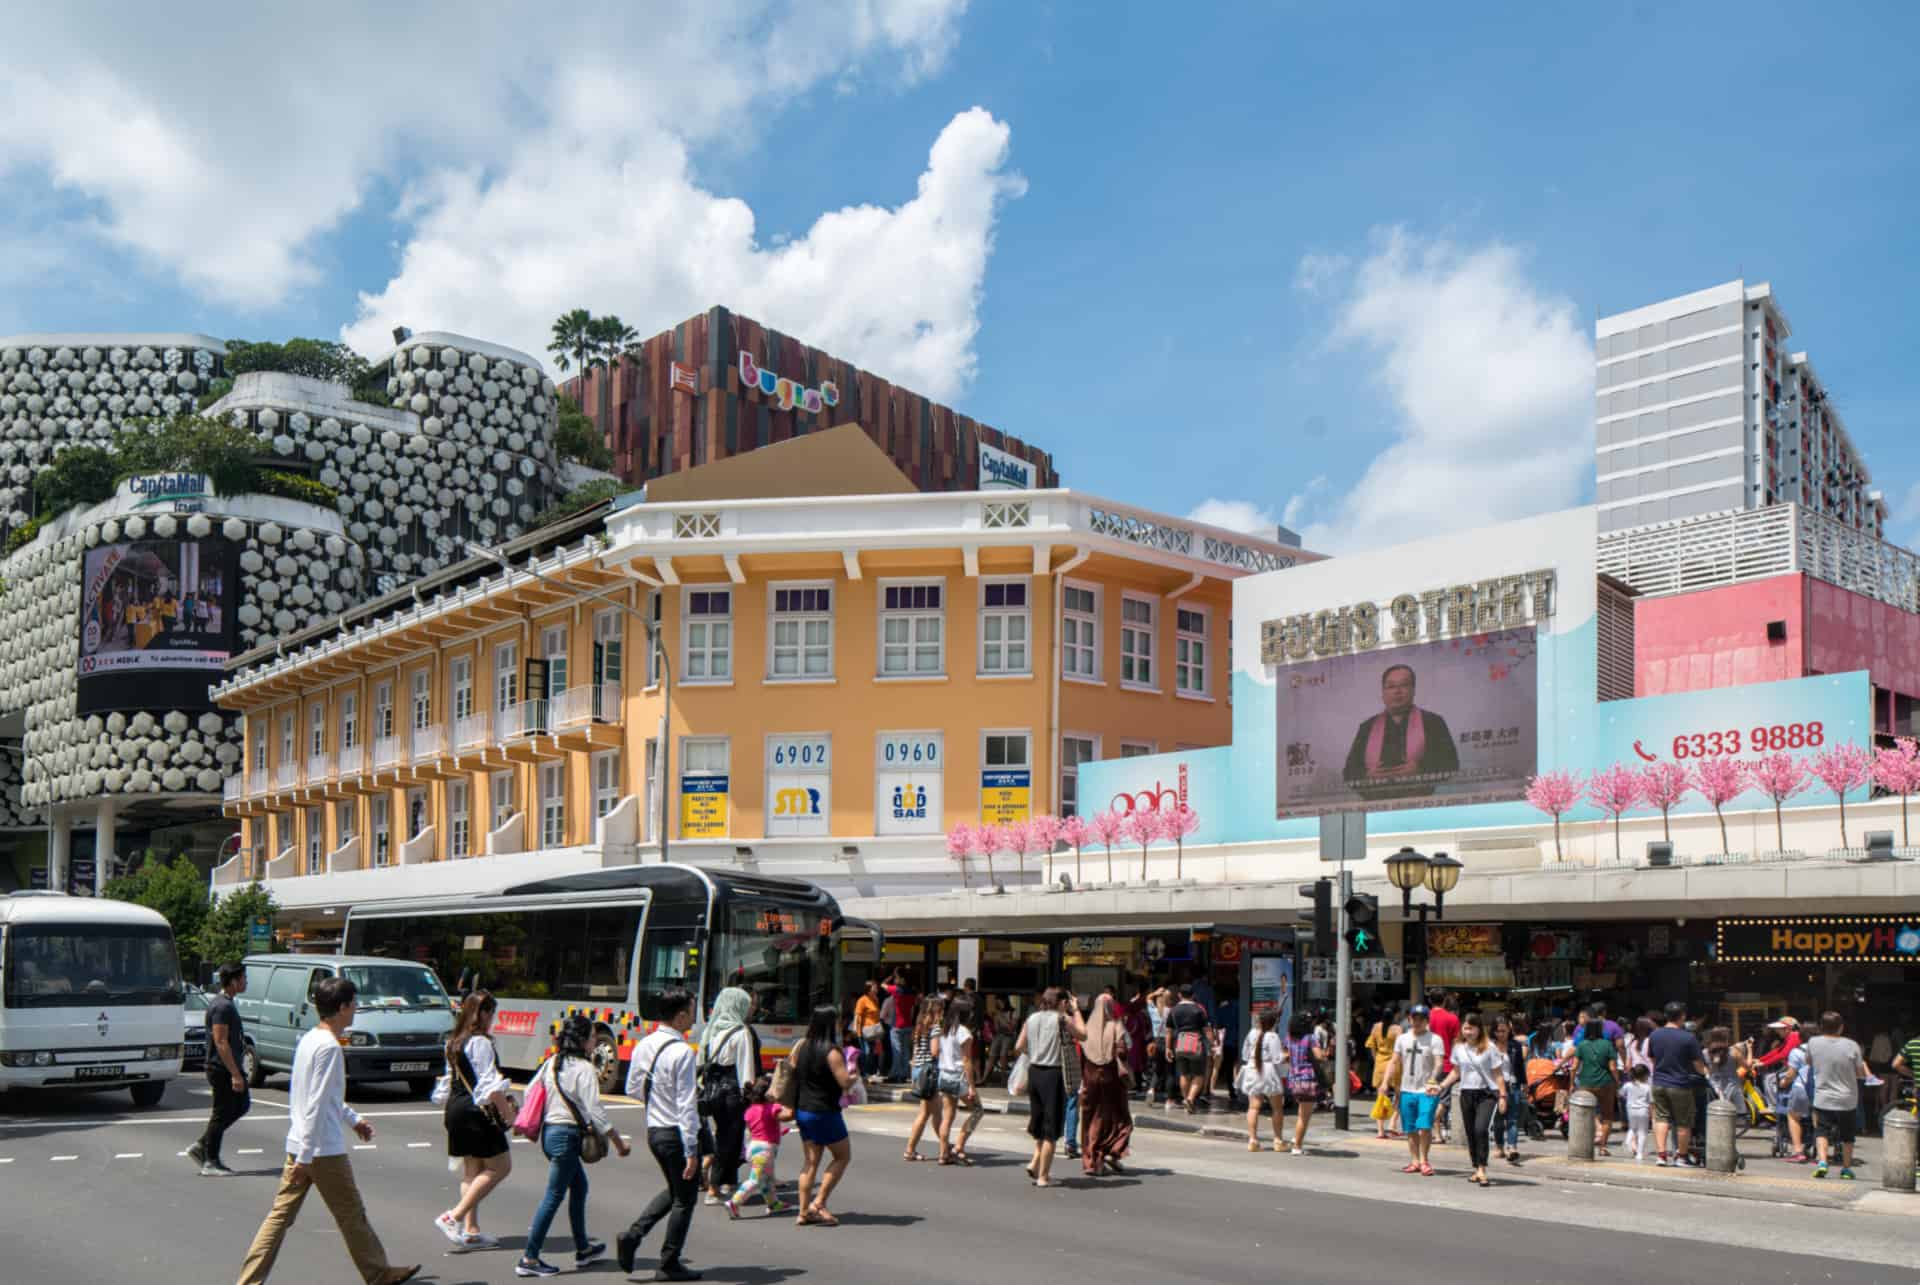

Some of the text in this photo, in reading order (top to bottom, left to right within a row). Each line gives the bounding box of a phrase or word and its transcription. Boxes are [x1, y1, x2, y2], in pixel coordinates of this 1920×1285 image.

[983, 451, 1028, 487] CapitaMall
[130, 473, 205, 498] CapitaMall
[1261, 568, 1557, 664] BUGIS STREET
[885, 742, 936, 761] 0960
[1672, 721, 1824, 760] 6333 9888
[775, 744, 825, 764] 6902
[893, 808, 927, 819] SAE
[494, 1010, 541, 1034] SMRT
